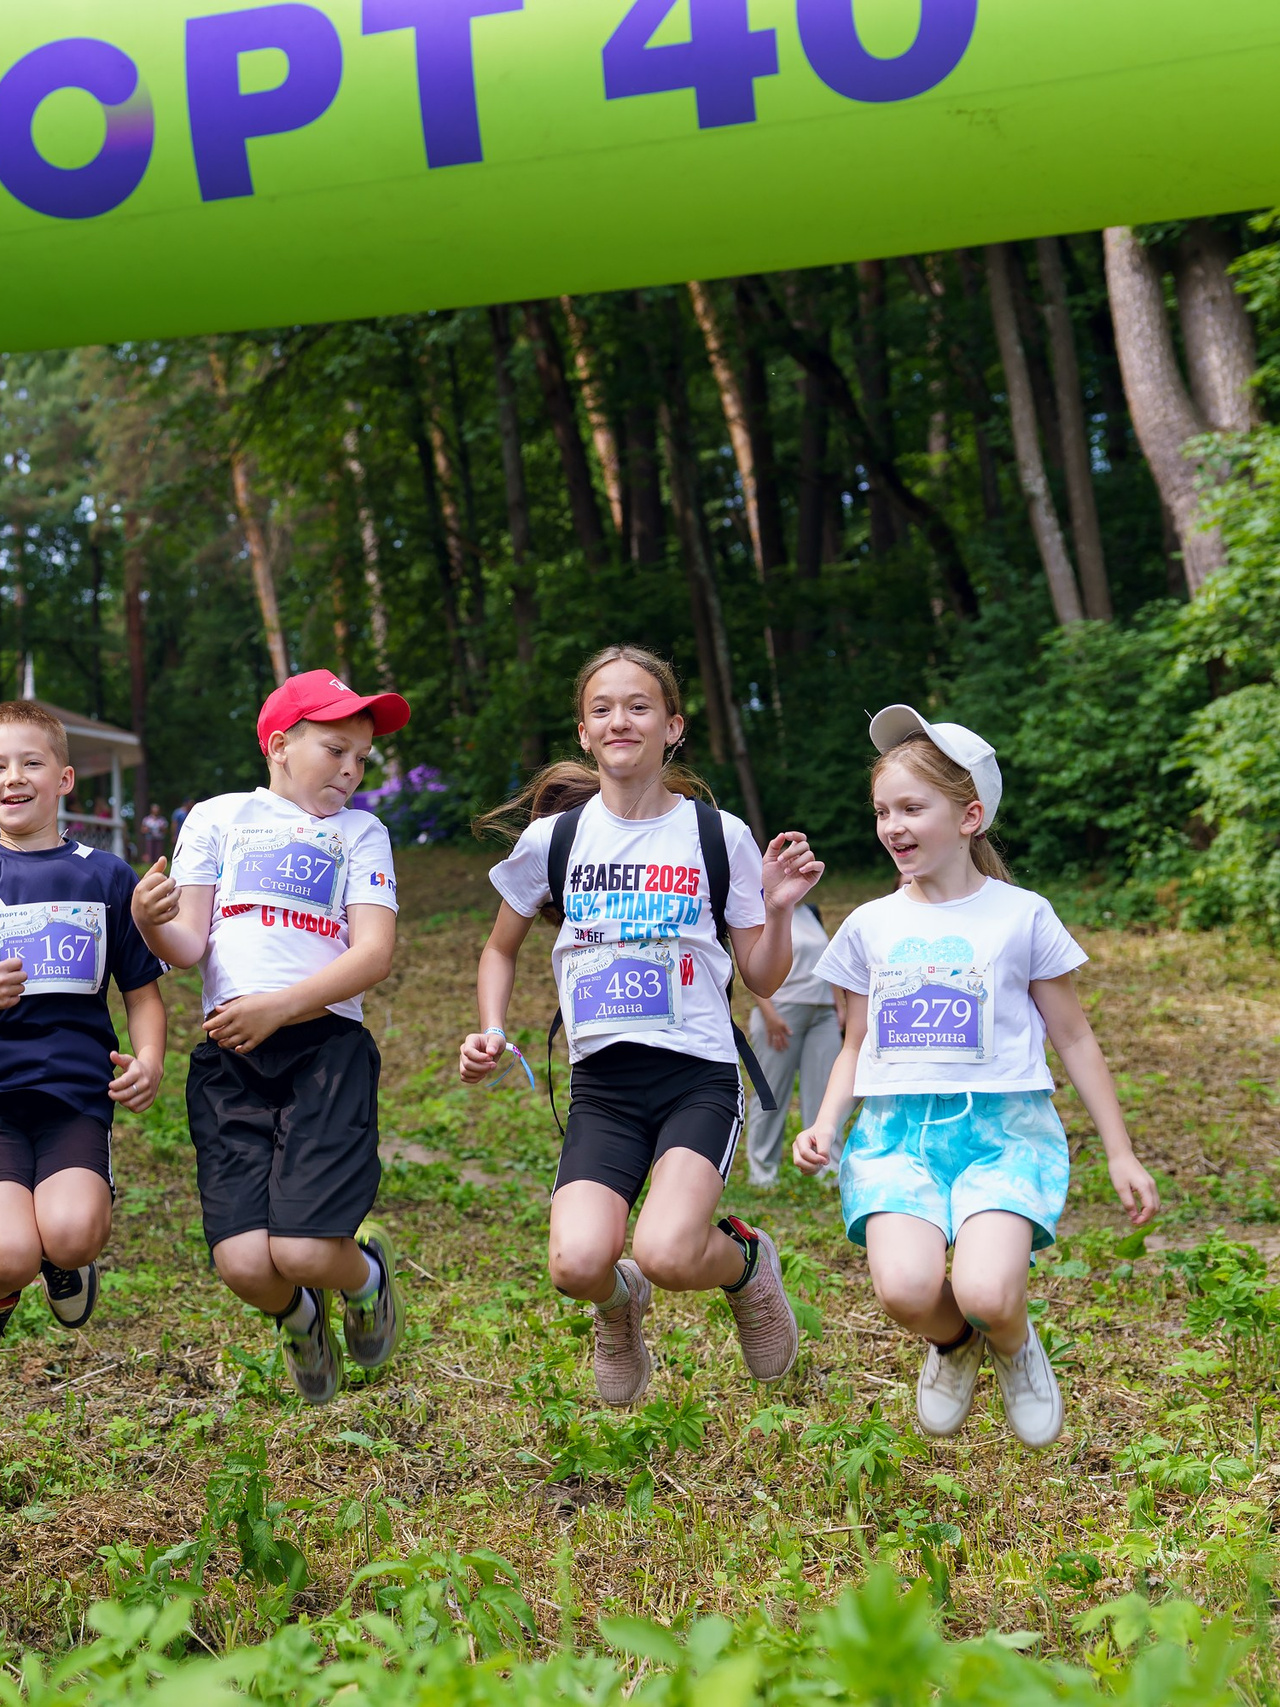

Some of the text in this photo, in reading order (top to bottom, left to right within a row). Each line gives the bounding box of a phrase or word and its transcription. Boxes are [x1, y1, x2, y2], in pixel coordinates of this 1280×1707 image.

[276, 853, 332, 884] 437
[570, 864, 700, 896] #ЗАБЕГ2025
[259, 876, 311, 897] Степан
[262, 905, 275, 926] С
[566, 893, 702, 926] 45% ПЛАНЕТЫ
[40, 934, 91, 962] 167
[571, 950, 587, 958] СПОРТ
[33, 962, 71, 976] Иван
[605, 969, 662, 1000] 483
[595, 1002, 643, 1019] Диана
[911, 998, 972, 1028] 279
[888, 1030, 966, 1046] Екатерина
